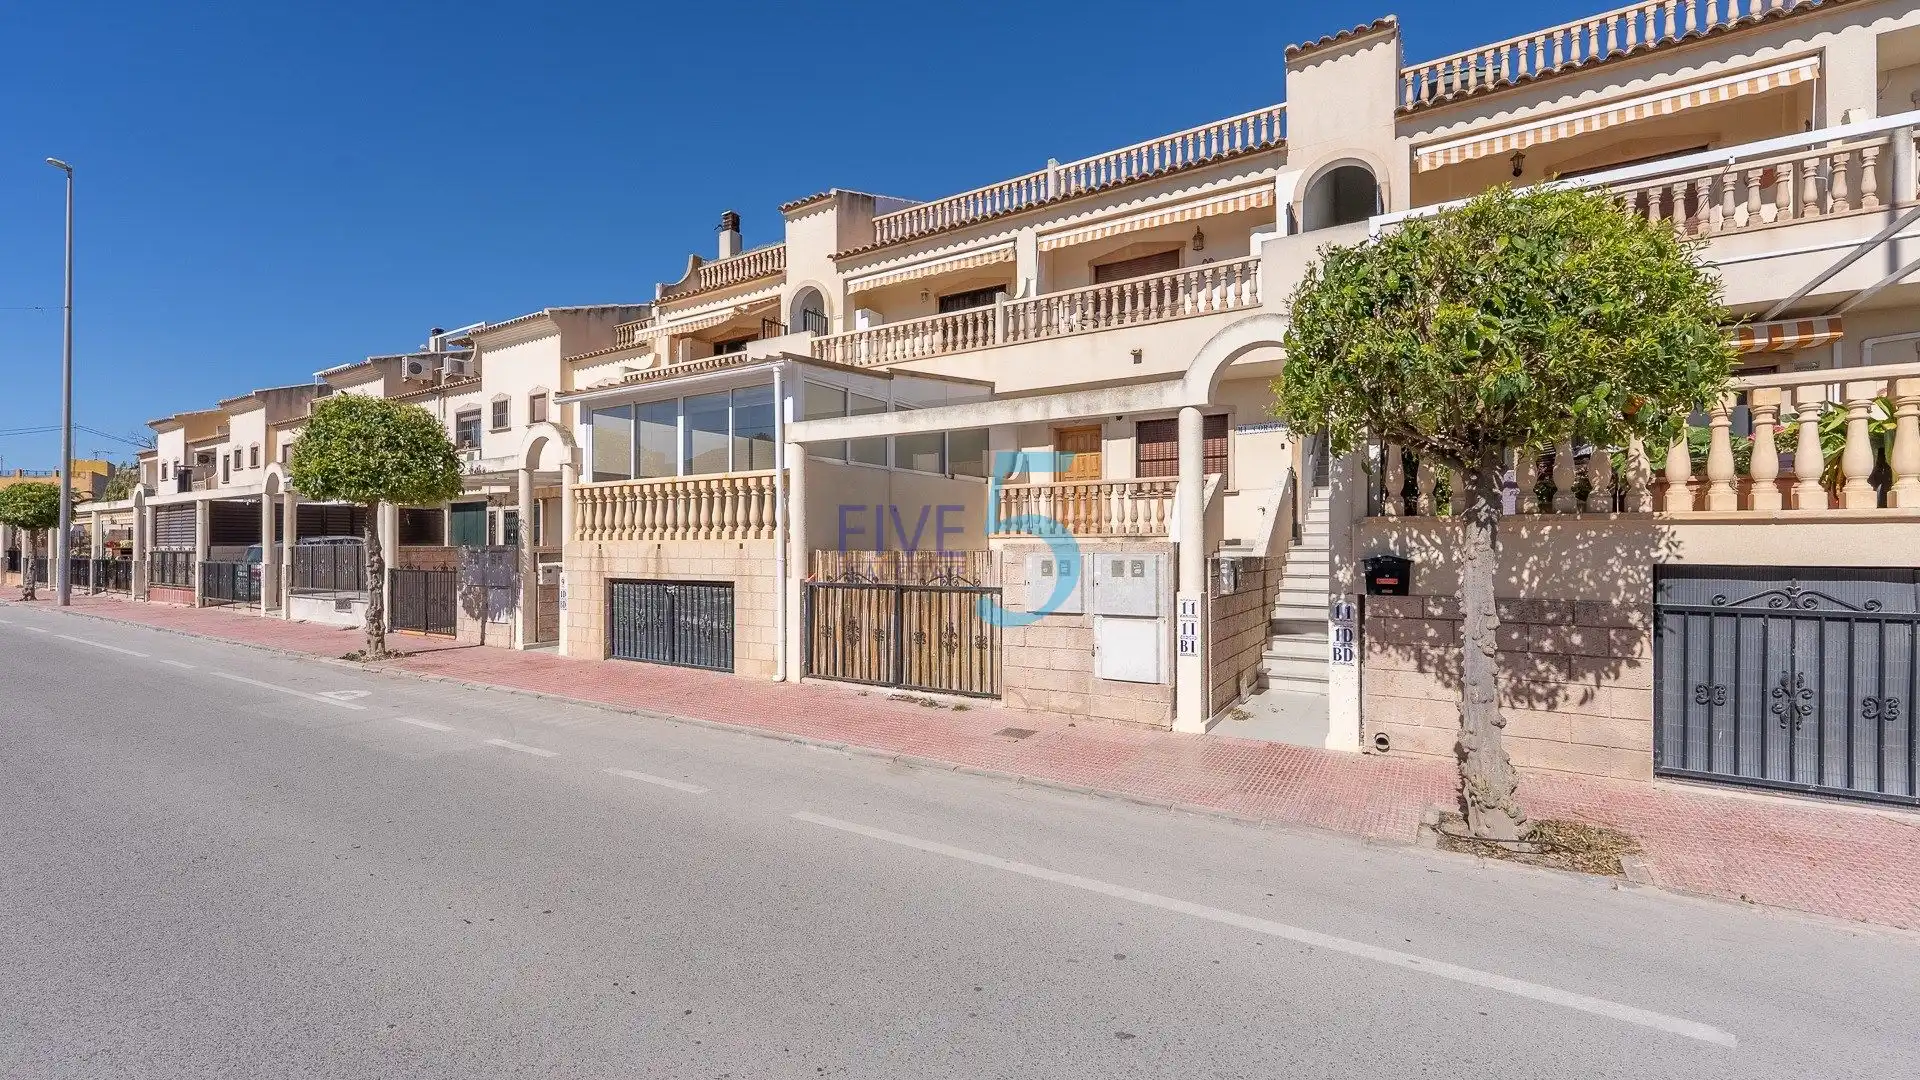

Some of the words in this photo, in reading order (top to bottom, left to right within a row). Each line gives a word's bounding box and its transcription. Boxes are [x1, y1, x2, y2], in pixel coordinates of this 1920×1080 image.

[1182, 601, 1195, 615] 11
[1335, 604, 1351, 619] 11
[1335, 628, 1353, 642] 1D
[1333, 647, 1353, 662] BD
